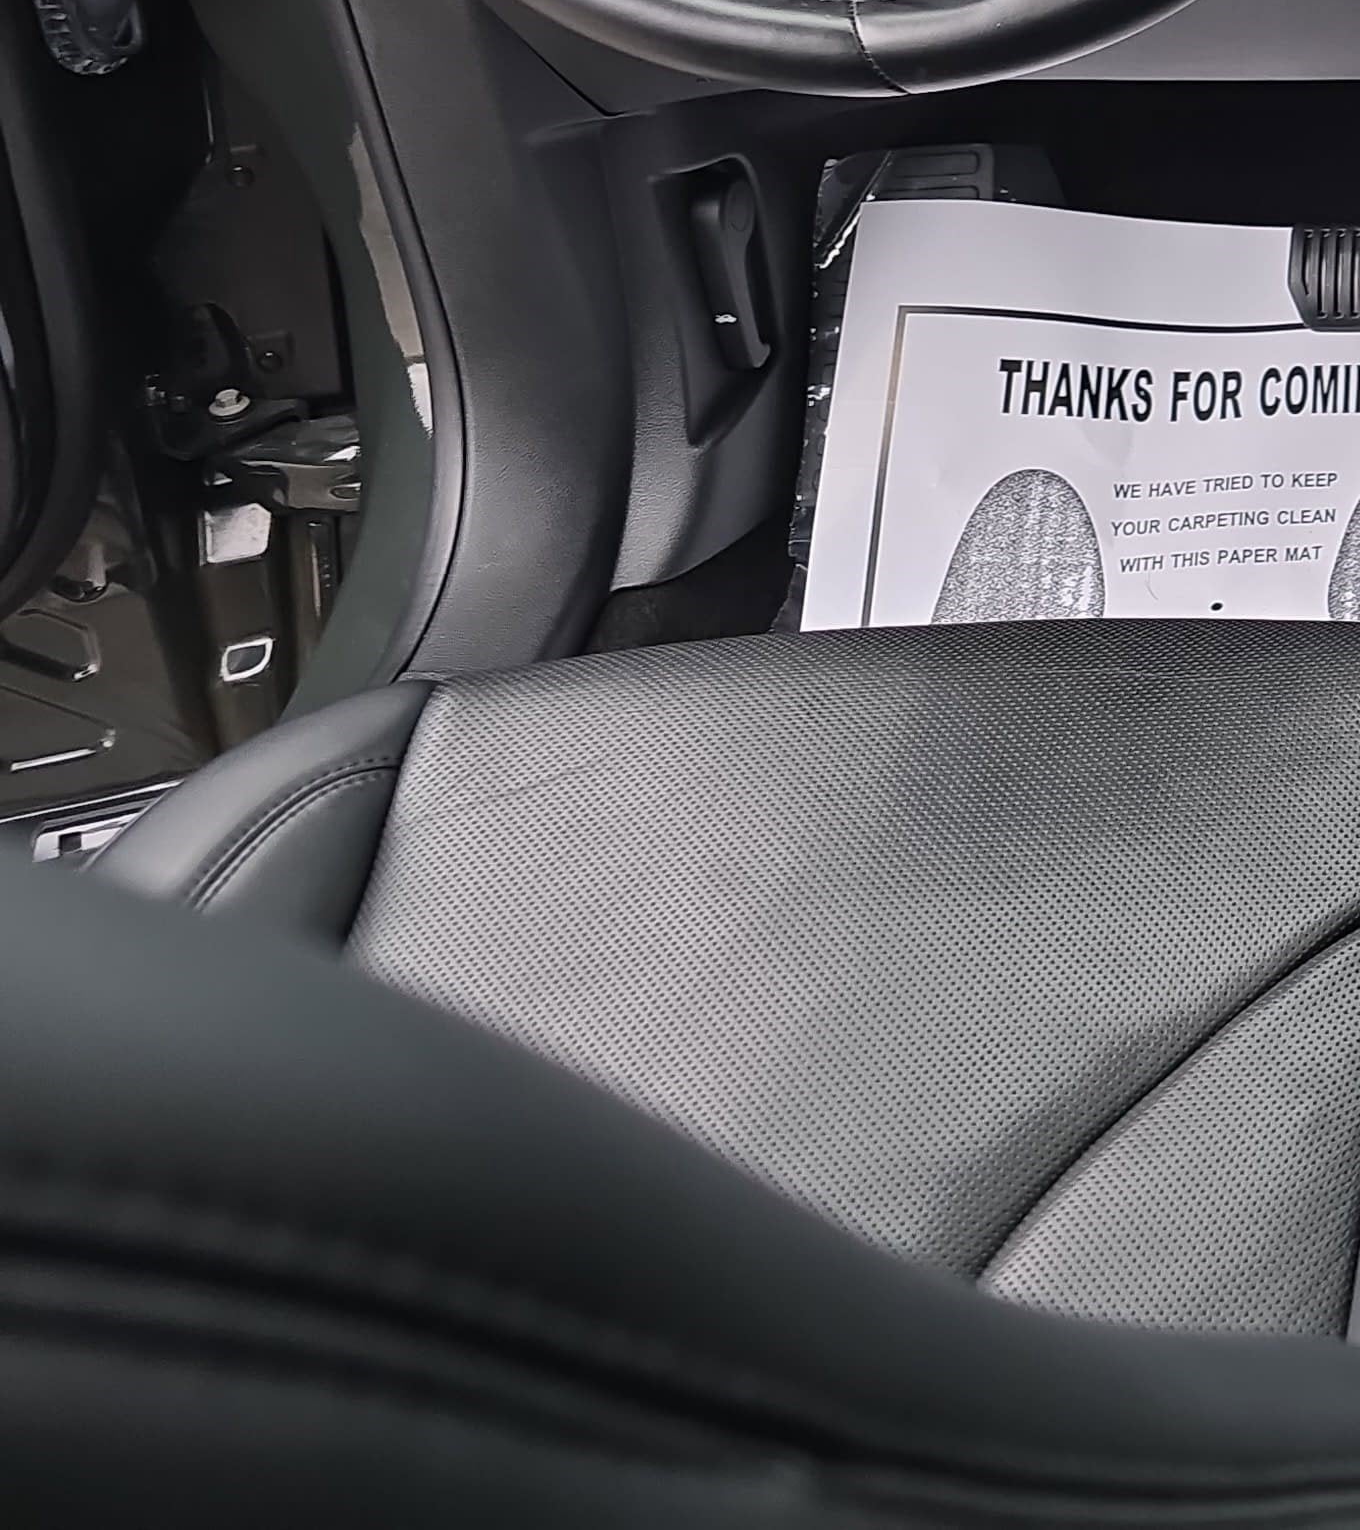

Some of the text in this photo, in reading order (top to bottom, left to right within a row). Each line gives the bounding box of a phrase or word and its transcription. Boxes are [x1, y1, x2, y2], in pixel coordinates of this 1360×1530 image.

[999, 358, 1153, 423] THANKS
[1169, 371, 1242, 422] FOR
[1113, 473, 1338, 499] WE HAVE TRIED TO KEEP
[1111, 508, 1336, 537] YOUR CARPETING CLEAN
[1120, 545, 1323, 573] WITH THIS PAPER MAT
